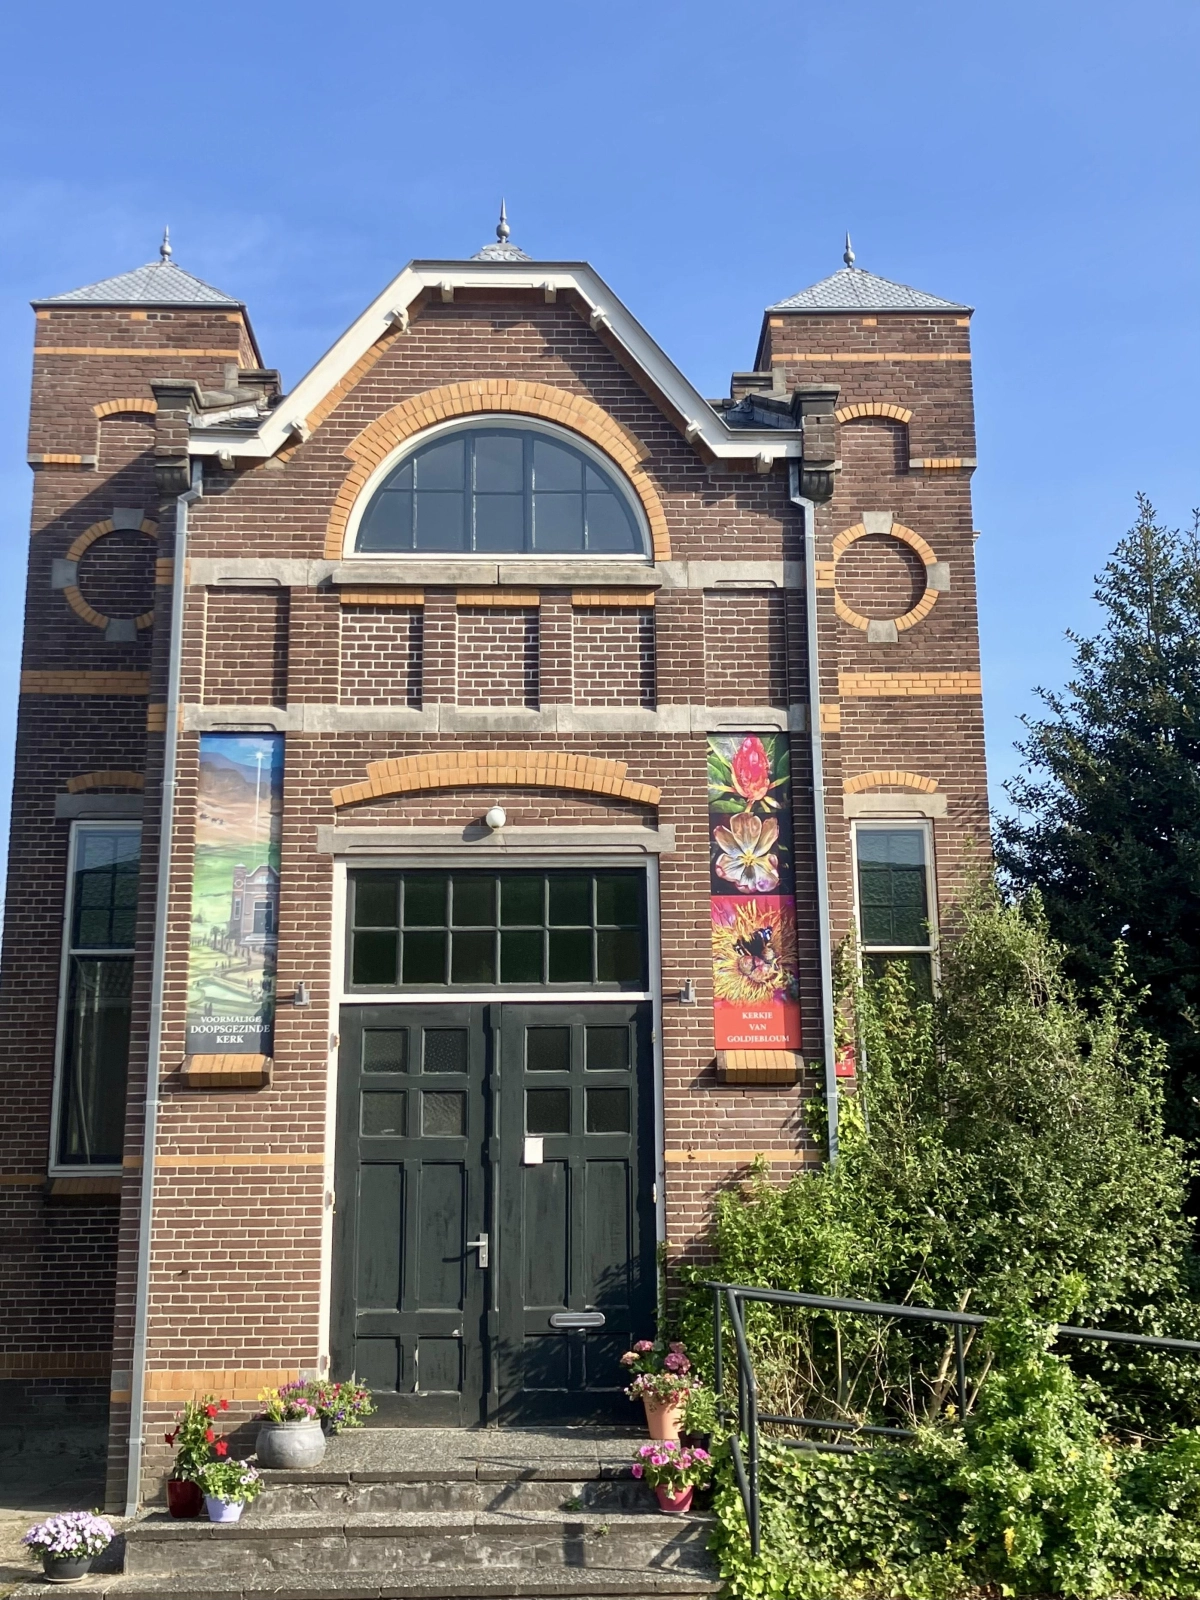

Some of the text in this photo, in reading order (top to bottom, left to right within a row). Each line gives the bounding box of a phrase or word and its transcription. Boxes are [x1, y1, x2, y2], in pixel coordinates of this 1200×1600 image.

[742, 1012, 773, 1020] KERKJE
[190, 1025, 270, 1034] DOOPSGEZINDE
[216, 1035, 244, 1044] KERK
